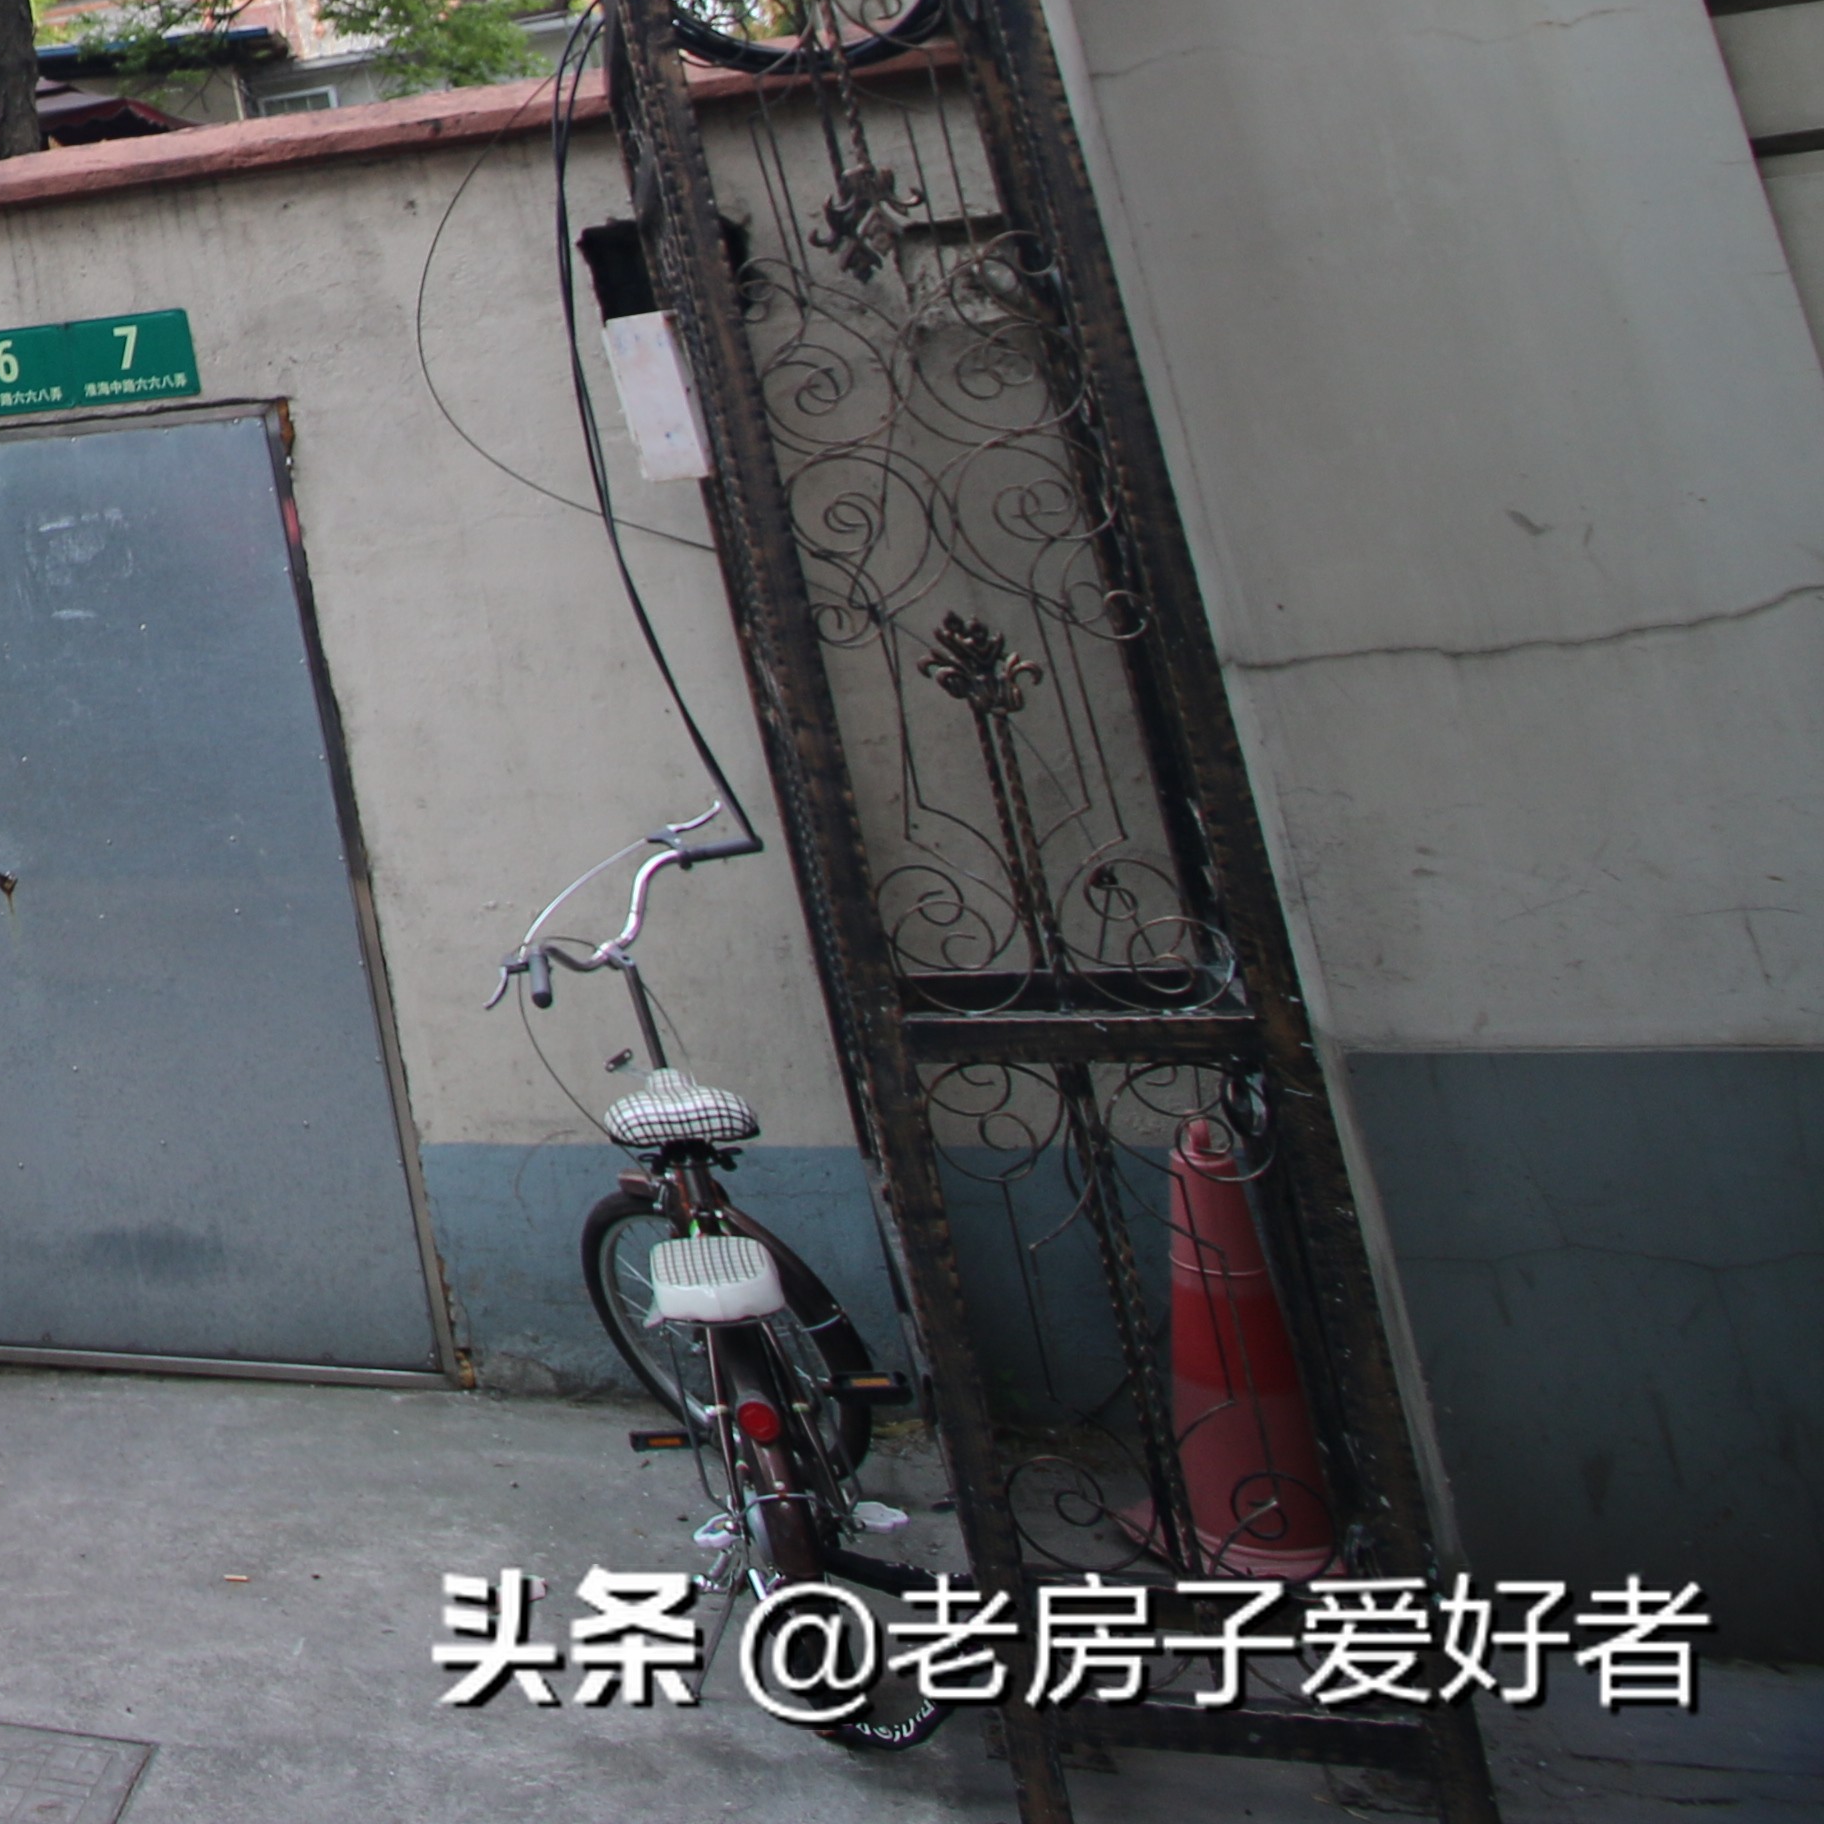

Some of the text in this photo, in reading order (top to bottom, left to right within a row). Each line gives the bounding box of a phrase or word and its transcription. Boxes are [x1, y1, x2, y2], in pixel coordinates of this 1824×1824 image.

[112, 325, 138, 371] 7
[84, 372, 188, 398] 淮海中路六六八弄
